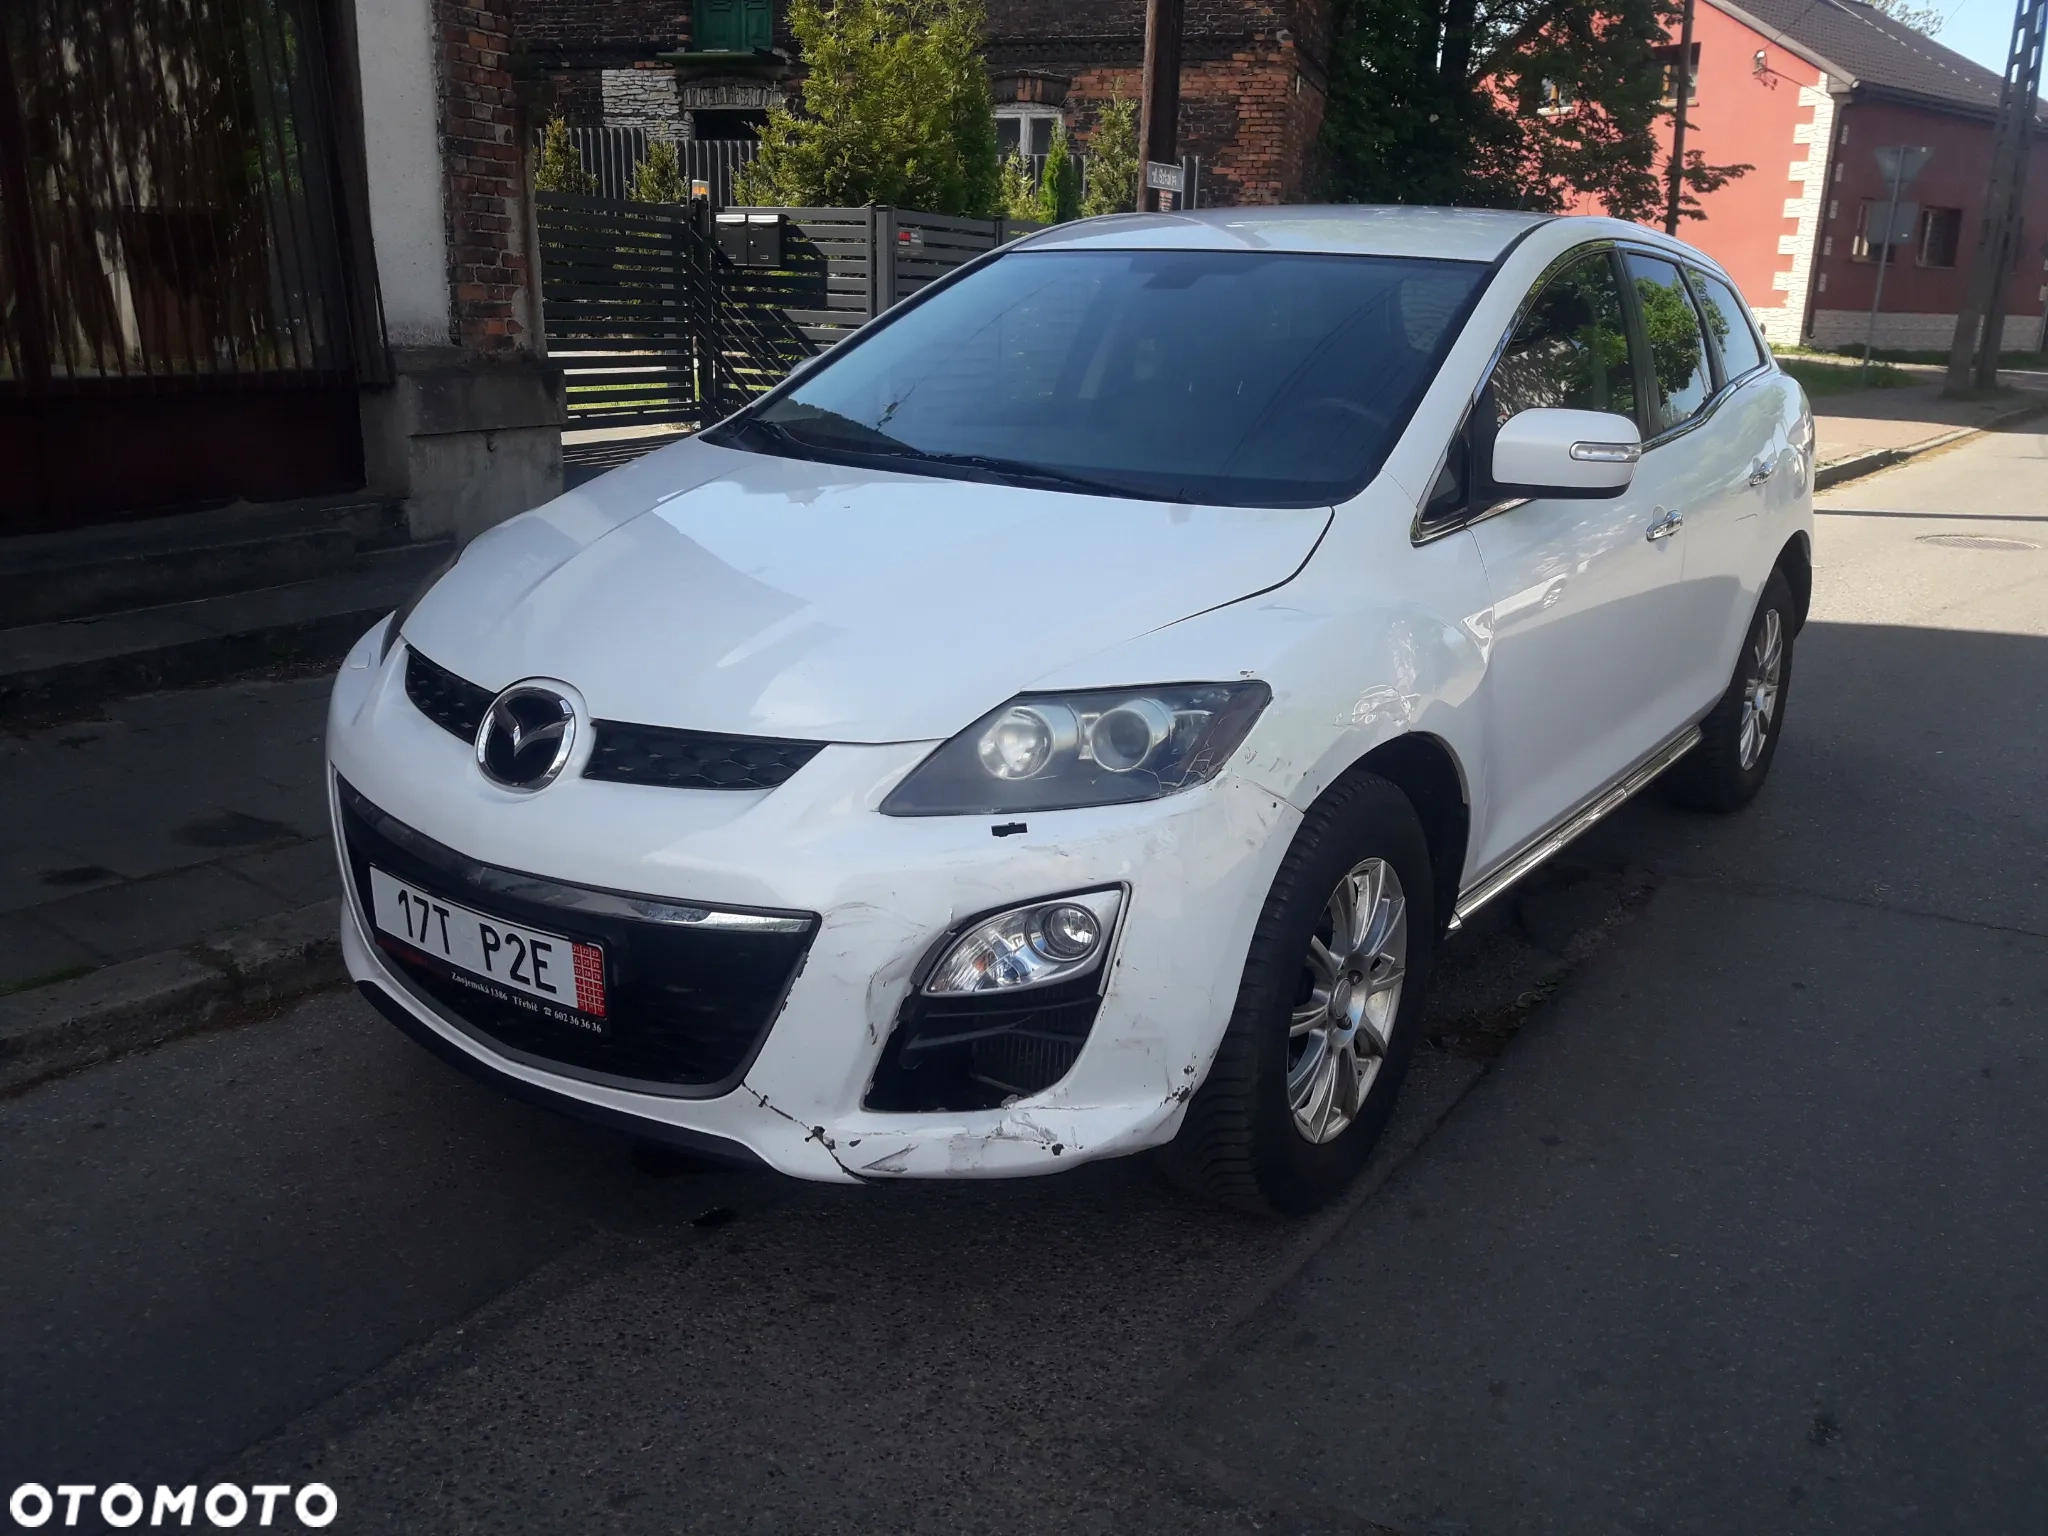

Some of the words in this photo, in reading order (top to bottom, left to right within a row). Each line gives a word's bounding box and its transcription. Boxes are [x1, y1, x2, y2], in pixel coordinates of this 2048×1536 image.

[398, 889, 451, 955] 17T
[479, 922, 557, 994] P2E
[452, 972, 489, 994] Znojemská
[491, 987, 508, 1001] 1386
[554, 1010, 568, 1022] 602
[570, 1015, 579, 1026] 36
[581, 1018, 590, 1029] 36
[592, 1022, 602, 1033] 36
